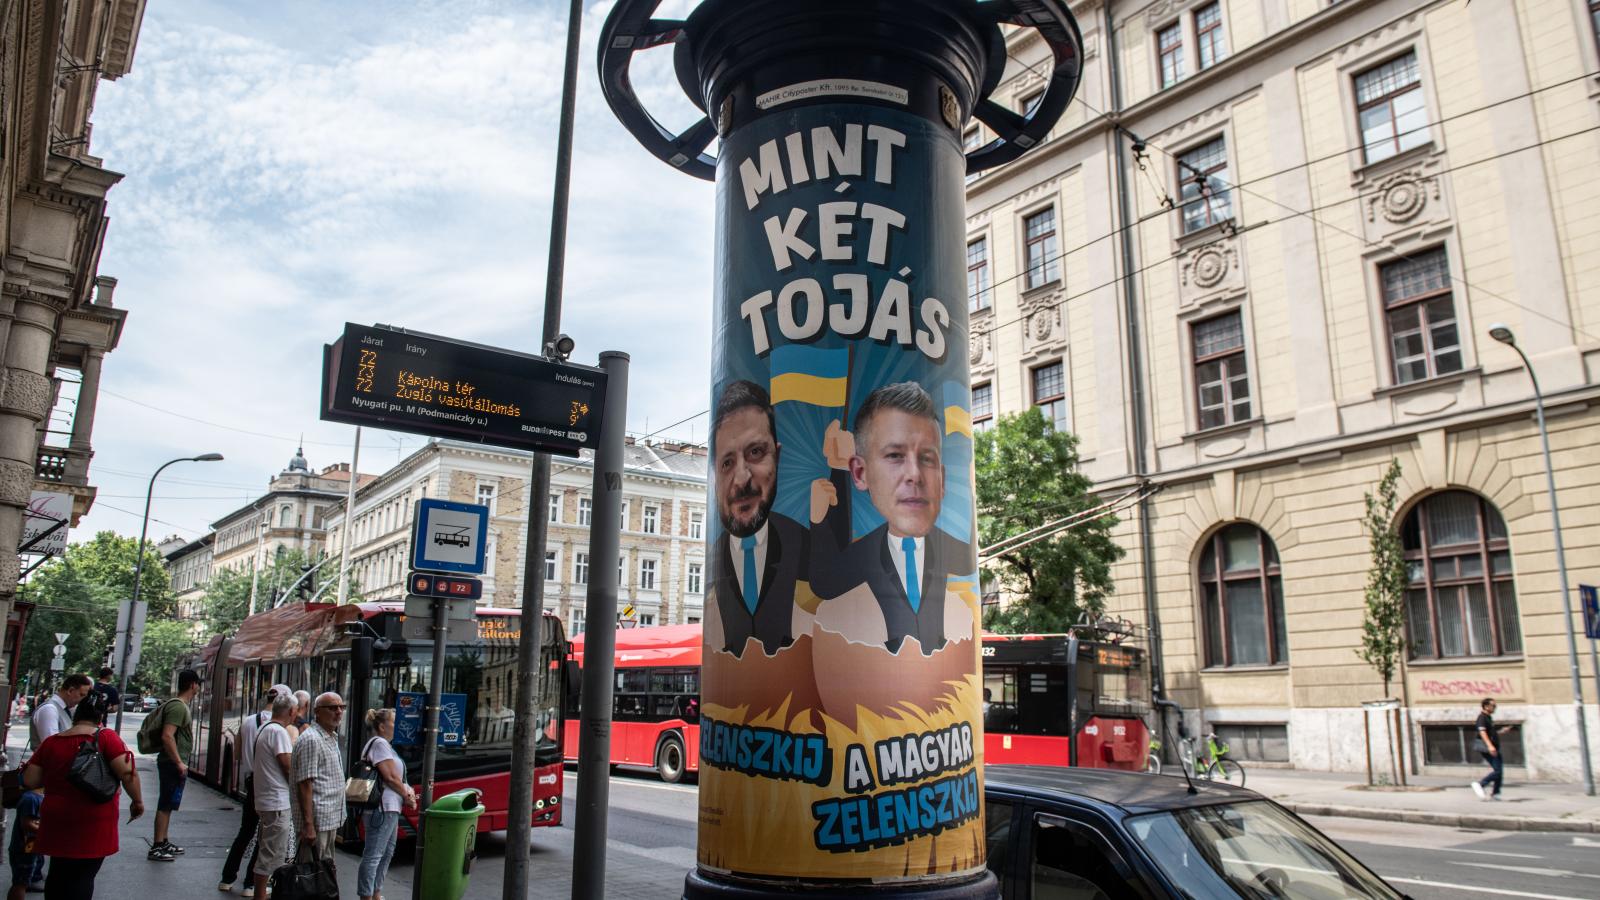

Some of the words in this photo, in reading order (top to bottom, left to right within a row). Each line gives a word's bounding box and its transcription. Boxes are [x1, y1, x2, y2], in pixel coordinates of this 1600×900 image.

[759, 94, 781, 106] MAHIR
[783, 87, 817, 98] Cityposter
[739, 124, 905, 210] MINT
[764, 182, 905, 271] KÉT
[741, 267, 949, 359] TOJÁS
[361, 349, 377, 365] 72
[361, 336, 384, 346] Járat
[406, 344, 427, 357] Irány
[555, 373, 581, 385] Indulás
[356, 377, 373, 392] 72
[396, 384, 432, 402] Zugló
[439, 394, 521, 417] vasútállomás
[359, 364, 375, 378] 73
[398, 370, 449, 391] Kápolna
[455, 381, 476, 395] tér
[352, 396, 387, 409] Nyugati
[389, 403, 403, 412] pu.
[406, 405, 415, 413] M
[418, 407, 475, 424] (Podmaniczky
[477, 418, 488, 426] u.)
[24, 528, 65, 541] Eskvői
[456, 584, 466, 592] 72
[700, 713, 825, 781] ELENSZKIJ
[847, 746, 871, 791] A
[877, 723, 975, 783] MAGYAR
[814, 768, 979, 848] ZELENSZKIJ
